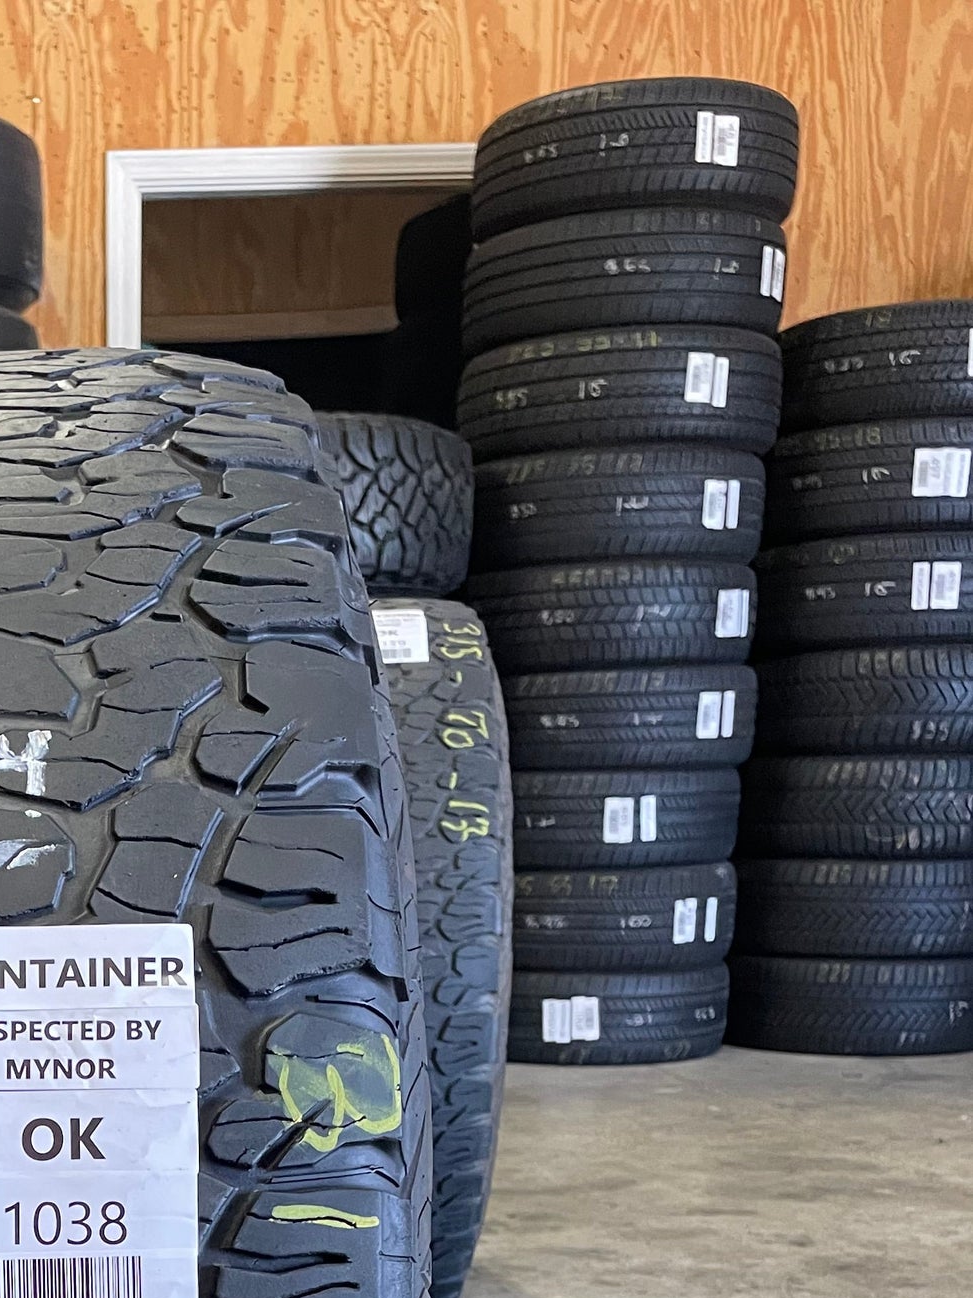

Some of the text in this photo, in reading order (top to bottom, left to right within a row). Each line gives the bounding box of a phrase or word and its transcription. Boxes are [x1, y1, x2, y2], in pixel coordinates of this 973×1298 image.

[126, 1020, 162, 1041] BY
[6, 1058, 117, 1080] MYNOR
[21, 1117, 107, 1161] OK
[4, 1201, 128, 1246] 1038
